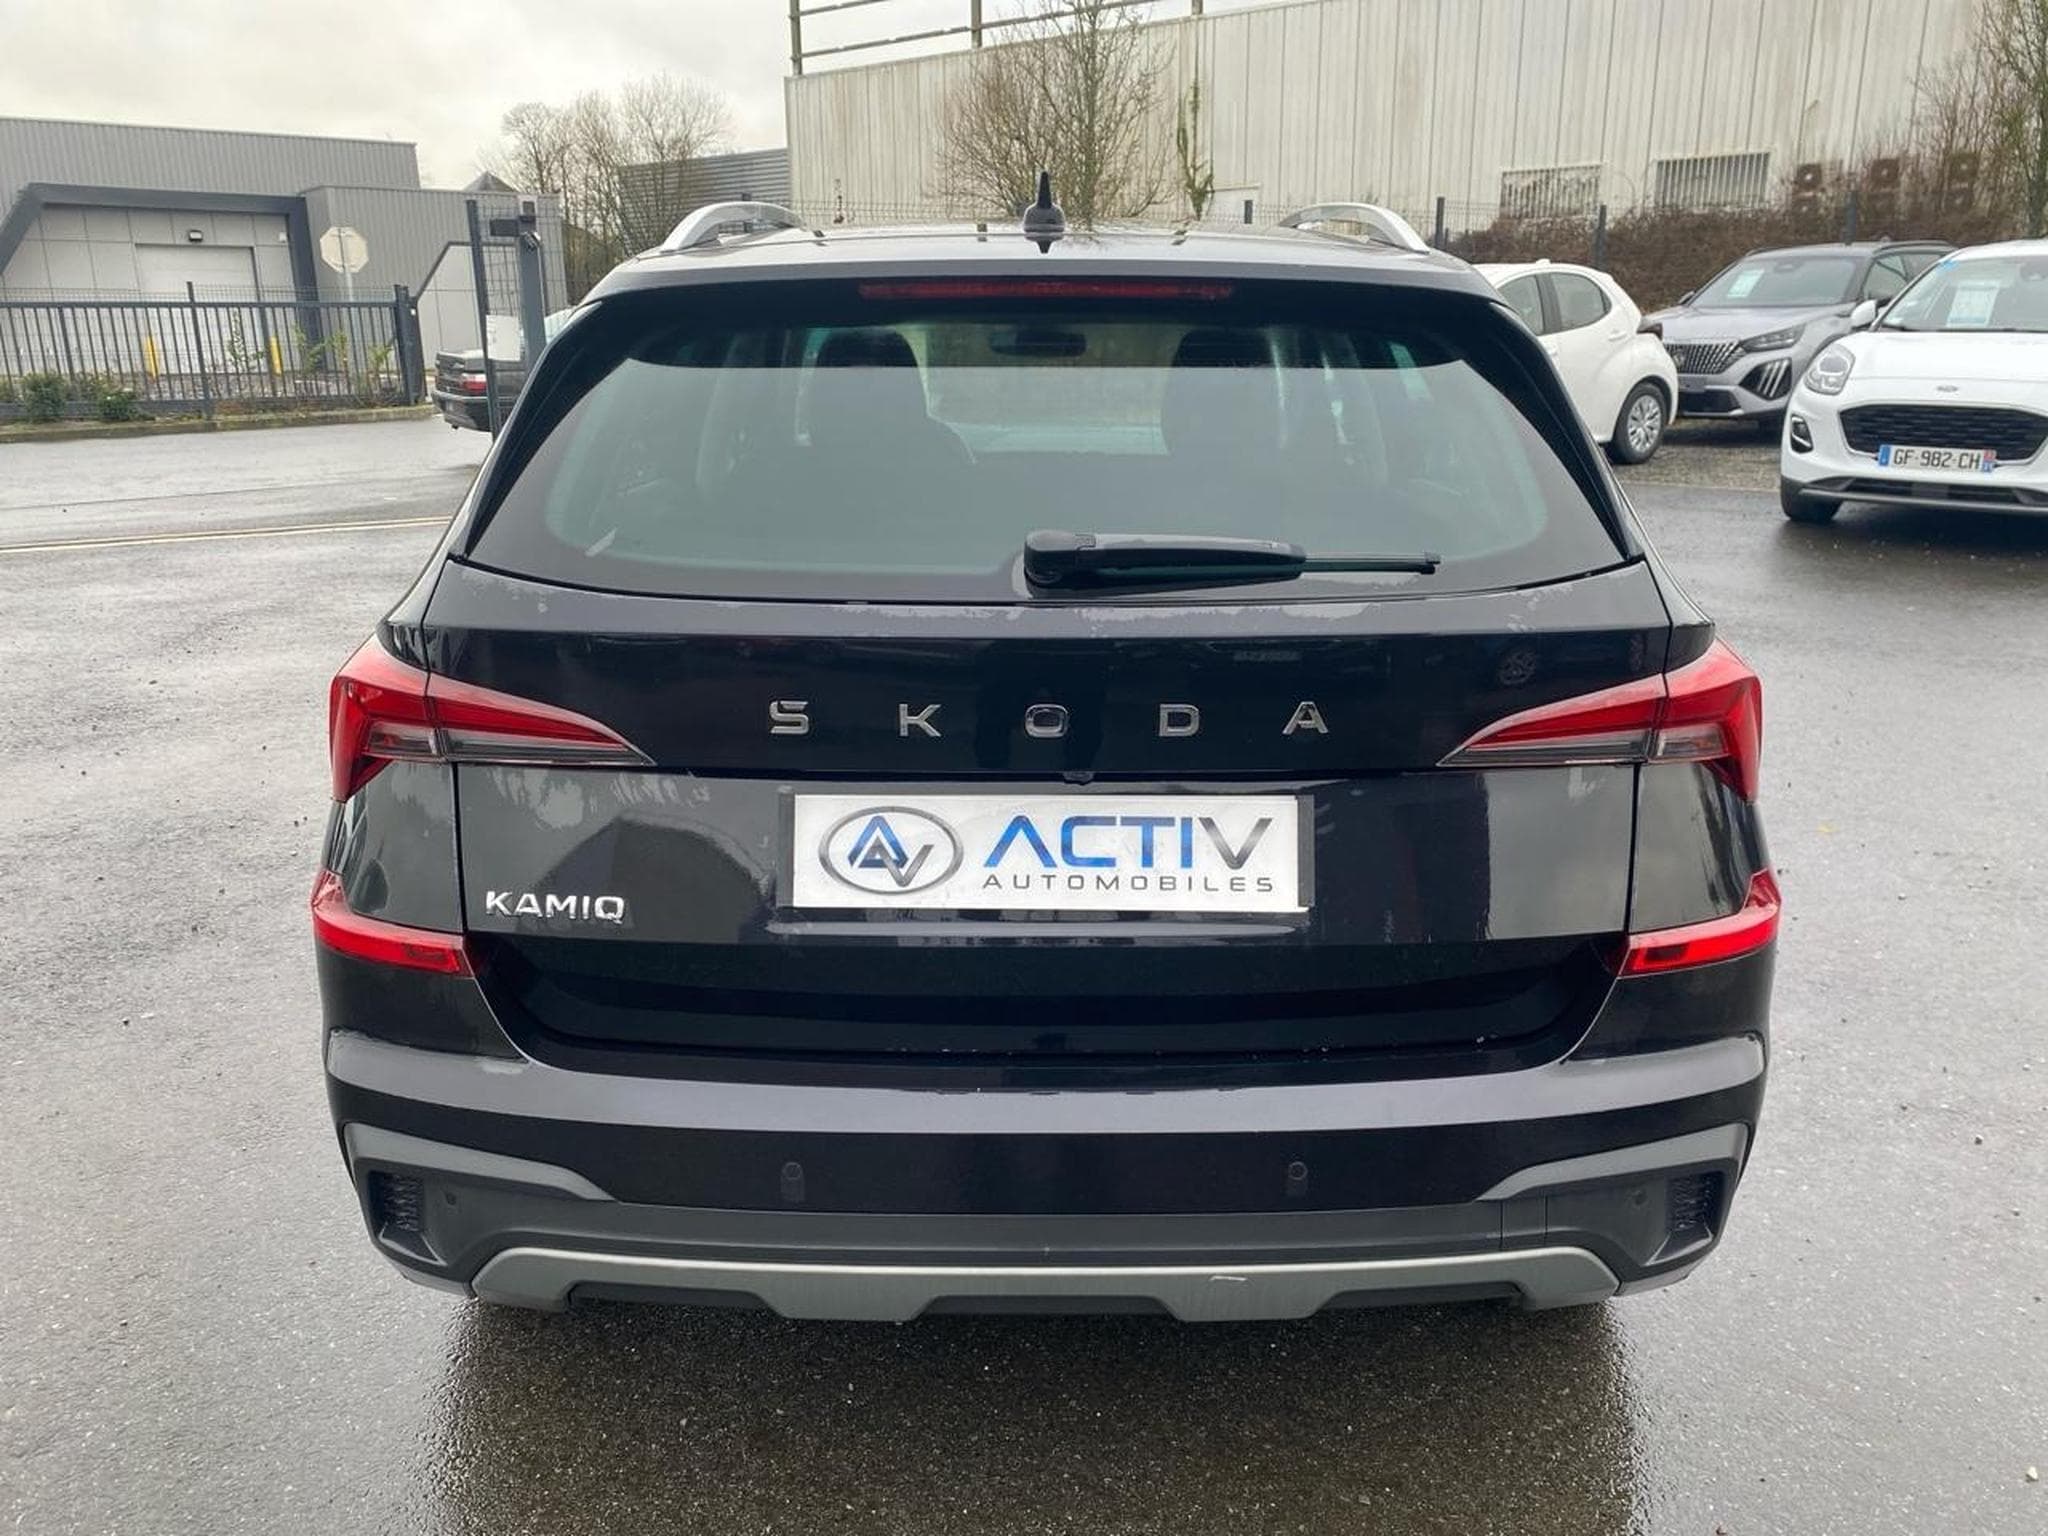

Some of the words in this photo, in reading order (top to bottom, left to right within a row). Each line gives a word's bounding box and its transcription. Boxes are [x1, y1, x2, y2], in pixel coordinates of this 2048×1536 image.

[769, 700, 1329, 738] SKODA
[983, 815, 1273, 870] ACTIV
[983, 874, 1274, 893] AUTOMOBILES
[485, 891, 625, 924] KAMIQ
